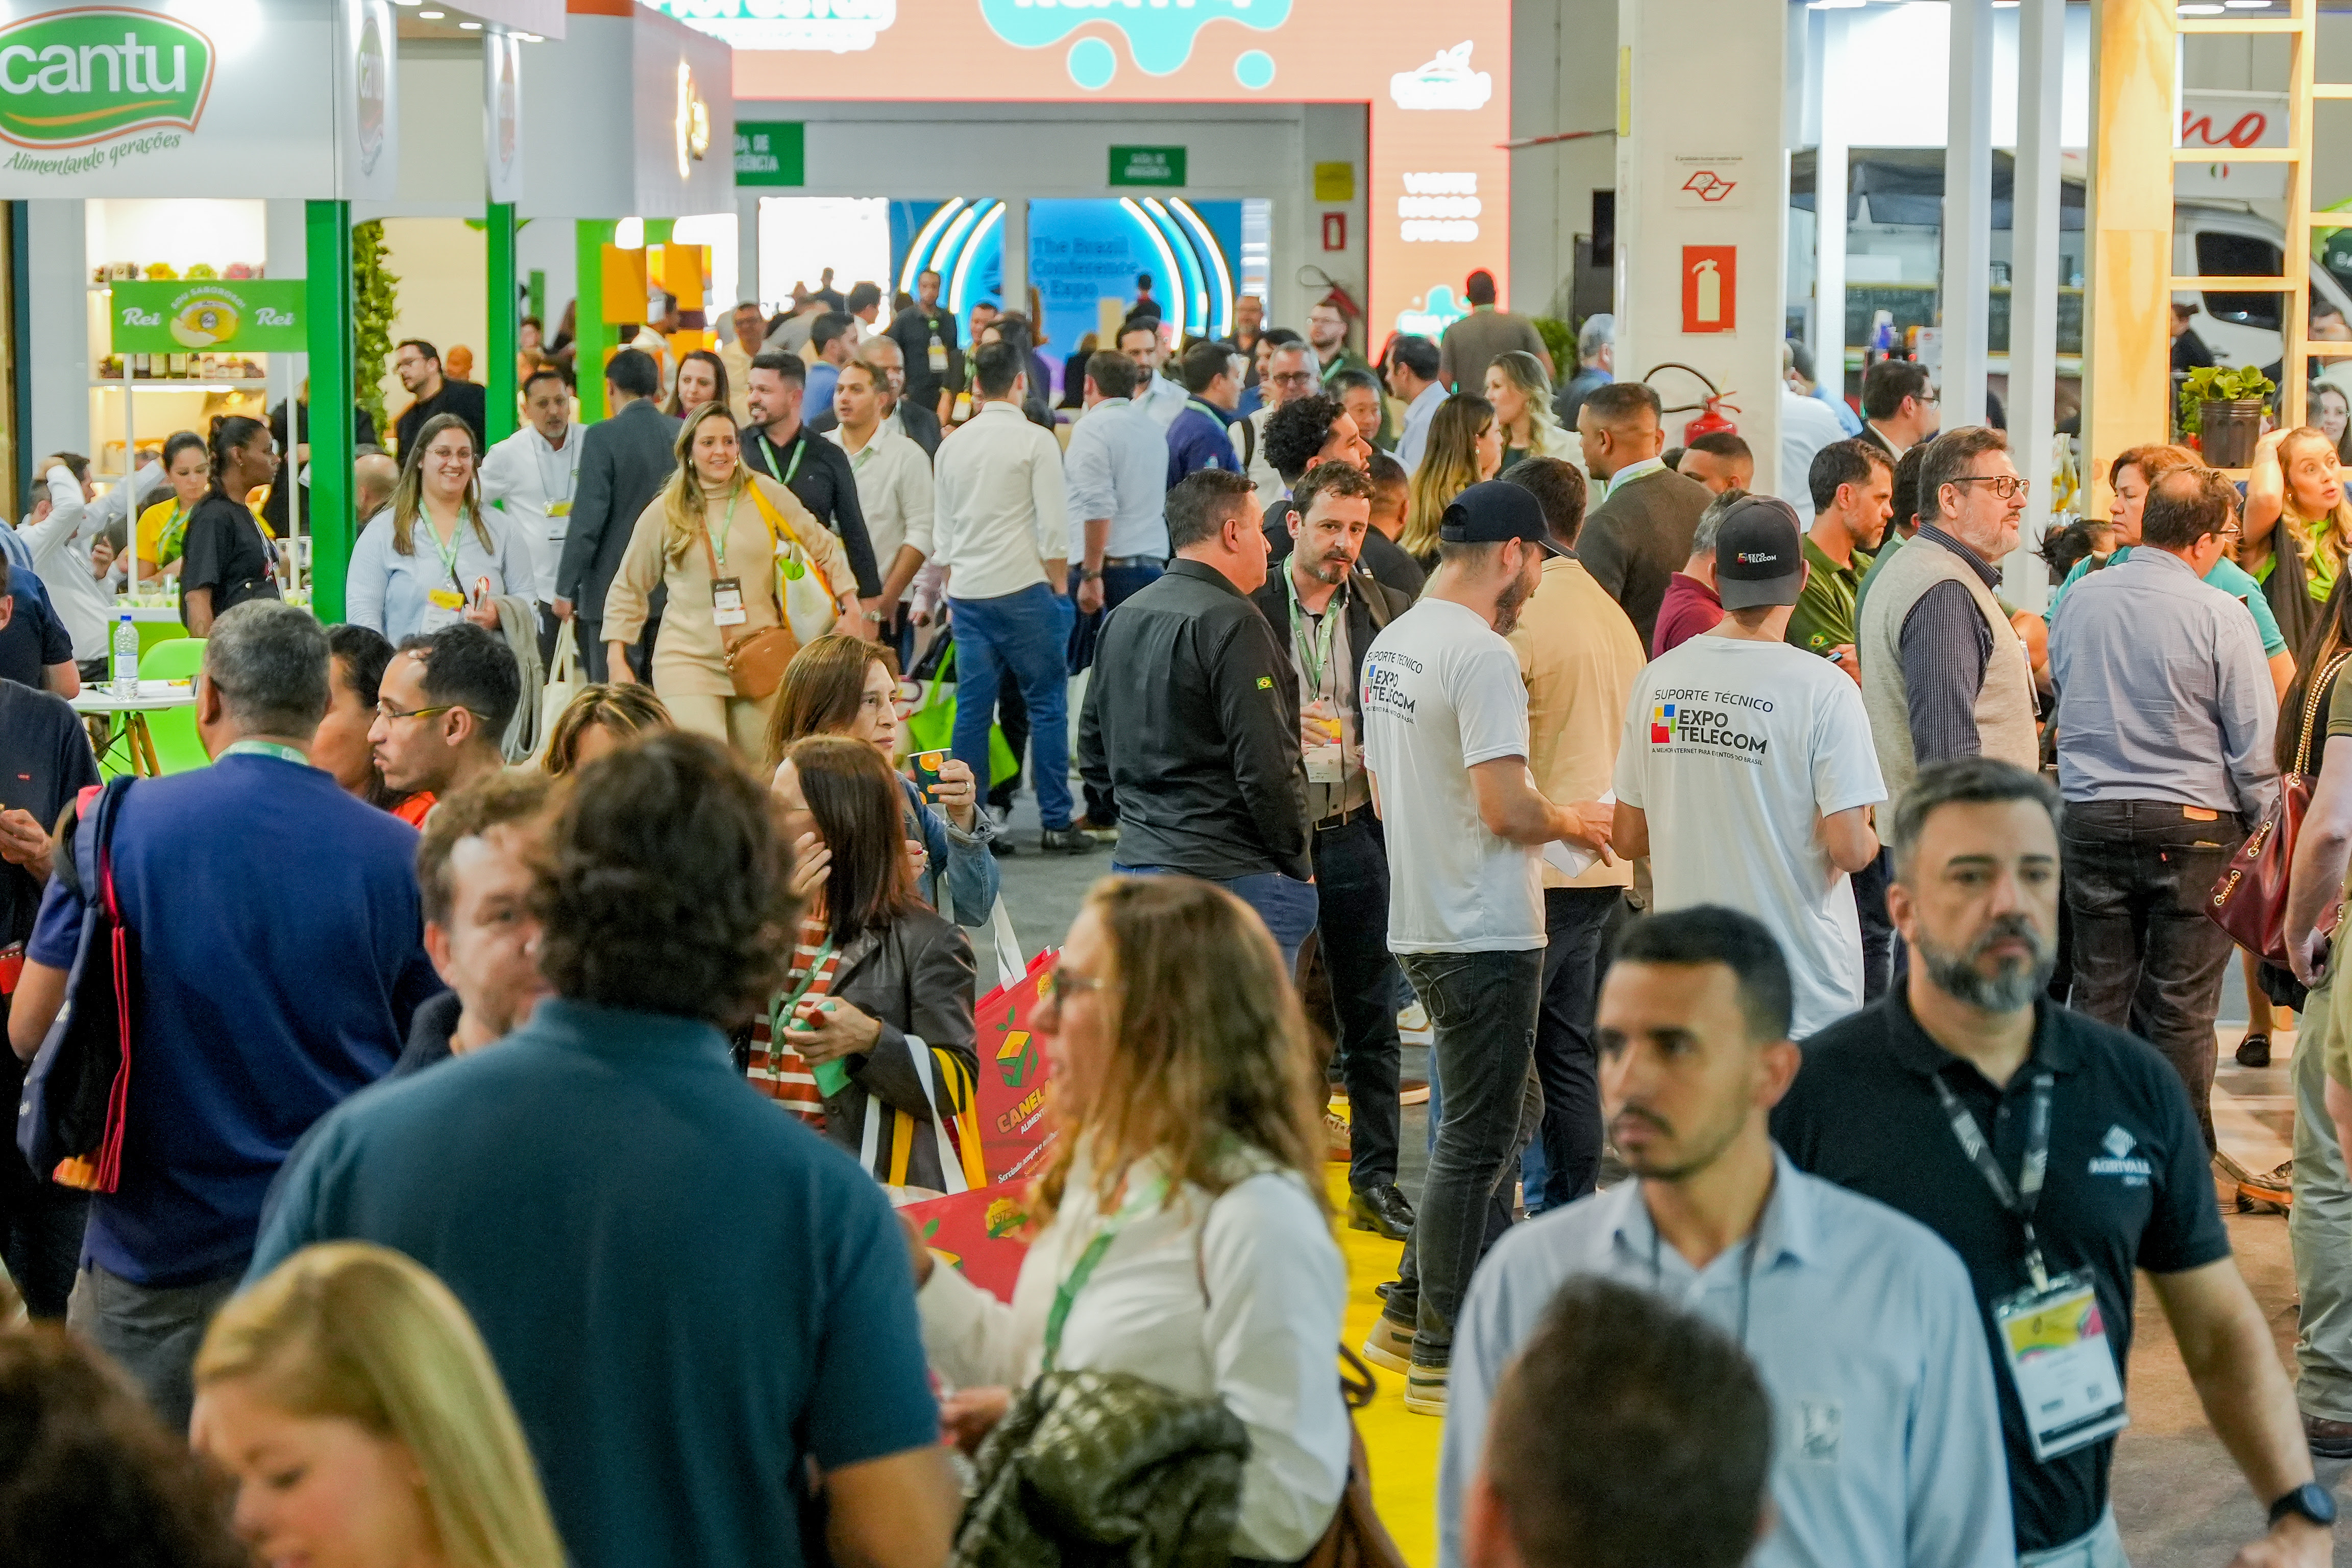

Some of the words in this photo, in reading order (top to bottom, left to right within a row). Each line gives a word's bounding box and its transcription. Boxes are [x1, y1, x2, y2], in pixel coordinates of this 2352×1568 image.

[0, 32, 186, 94] cantu
[3, 146, 105, 176] Alimentando
[109, 131, 181, 172] gerações
[1748, 554, 1777, 563] TELECOM
[1366, 651, 1396, 663] SUPORTE
[1396, 652, 1423, 674] TÉCNICO
[1654, 689, 1709, 701] SUPORTE
[1714, 691, 1773, 713] TÉCNICO
[1679, 709, 1728, 728] EXPO
[1677, 726, 1768, 754] TELECOM
